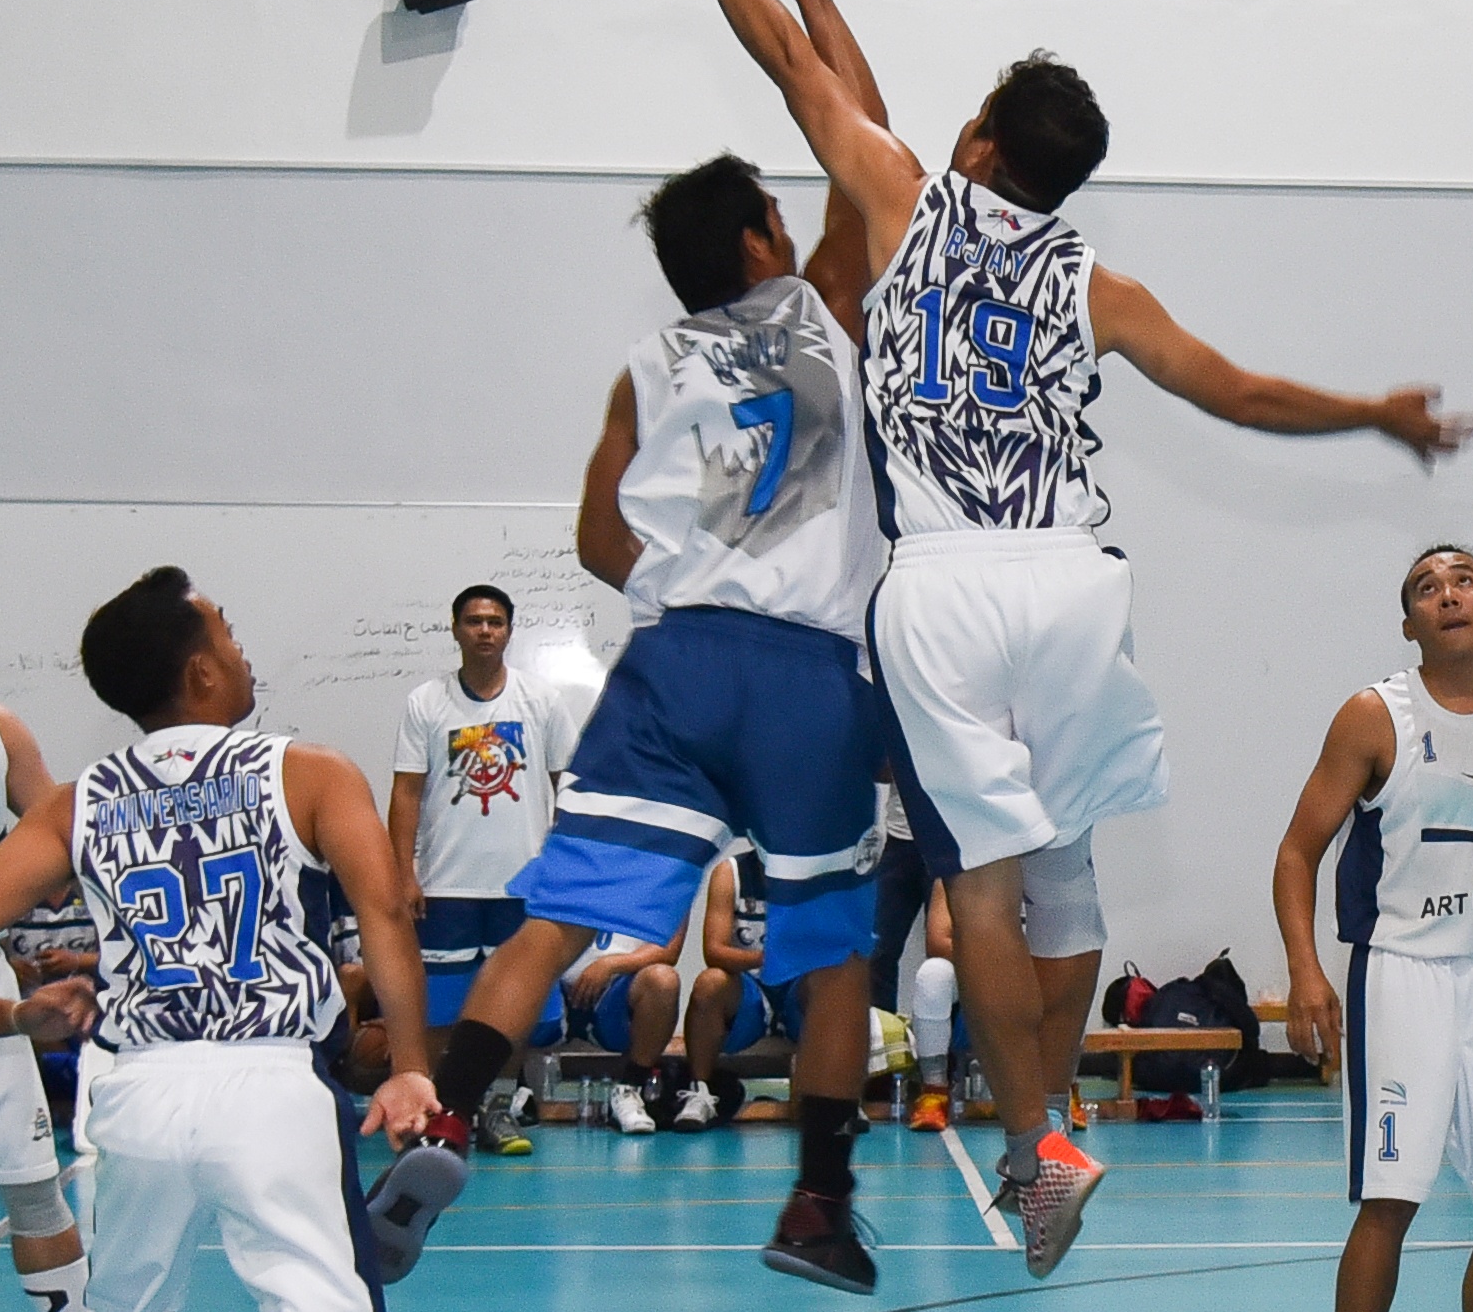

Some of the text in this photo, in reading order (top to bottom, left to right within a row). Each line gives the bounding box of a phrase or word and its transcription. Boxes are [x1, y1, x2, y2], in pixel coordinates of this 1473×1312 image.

[940, 223, 1029, 283] RJAY
[910, 286, 1038, 413] 19
[729, 388, 794, 517] 7
[1422, 730, 1437, 763] 1
[97, 771, 261, 838] ANIVERSARIO
[114, 844, 272, 992] 27
[1420, 892, 1469, 919] ART
[1378, 1111, 1399, 1162] 1
